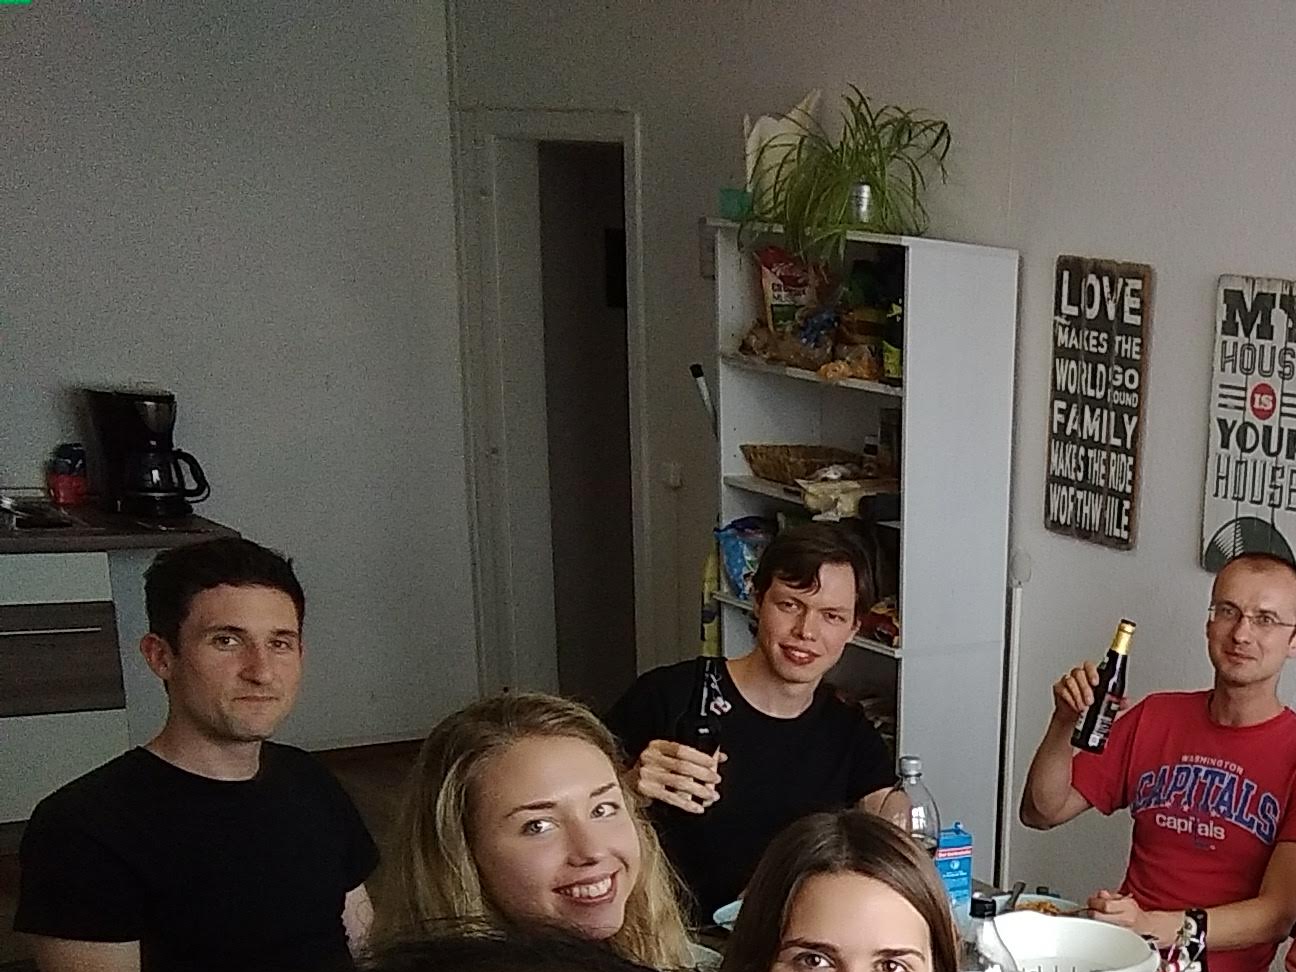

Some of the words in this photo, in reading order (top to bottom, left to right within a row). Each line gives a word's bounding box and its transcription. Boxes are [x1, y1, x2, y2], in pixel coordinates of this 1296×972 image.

[1061, 269, 1142, 325] LOVE
[1057, 324, 1108, 354] MAKES
[1114, 335, 1141, 360] THE
[1055, 358, 1106, 399] WORLD
[1108, 364, 1139, 390] GO
[1253, 393, 1273, 411] IS
[1053, 400, 1138, 450] FAMILY
[1050, 439, 1085, 482] MAKES
[1088, 448, 1107, 487] THE
[1109, 451, 1134, 493] RIDE
[1181, 755, 1244, 776] WASHINGTON
[1131, 764, 1280, 845] CAPITALS
[1155, 813, 1226, 840] capials
